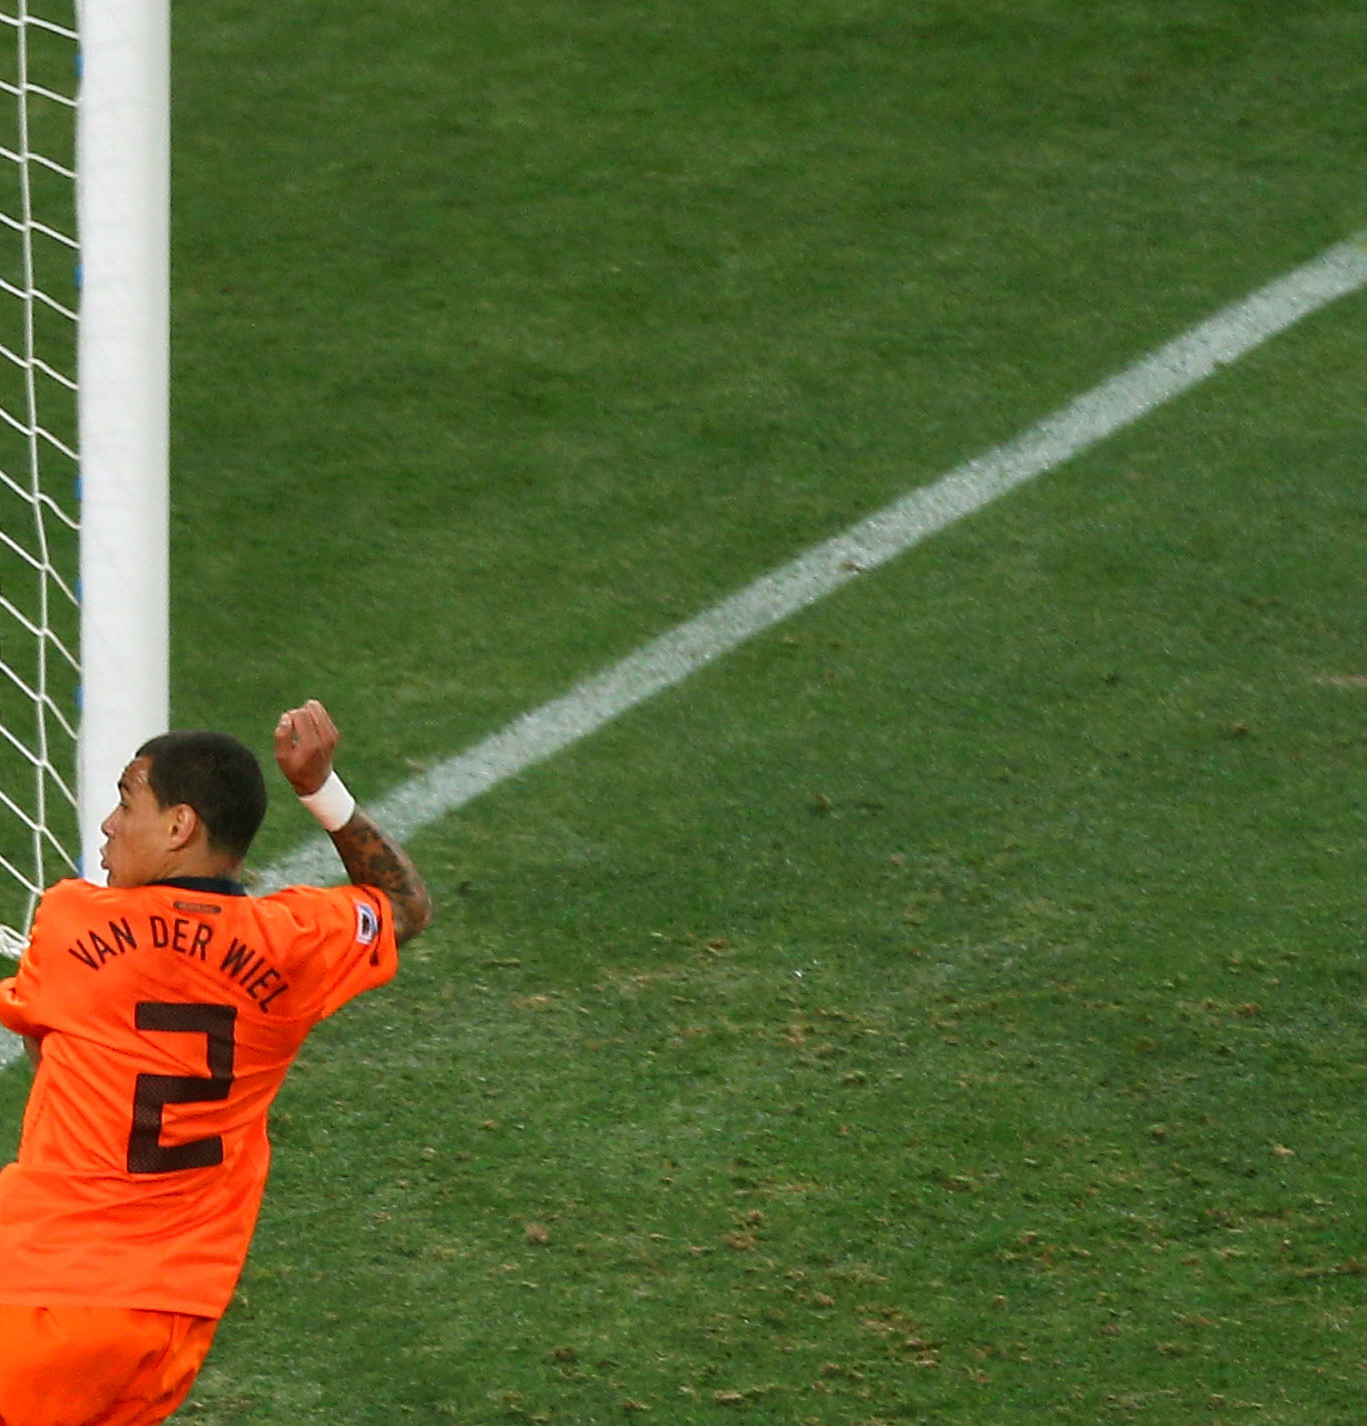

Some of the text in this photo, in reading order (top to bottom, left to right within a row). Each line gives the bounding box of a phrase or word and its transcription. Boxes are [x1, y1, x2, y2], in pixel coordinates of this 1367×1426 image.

[69, 915, 290, 1012] VAN DER WIEL
[127, 1001, 238, 1175] 2
